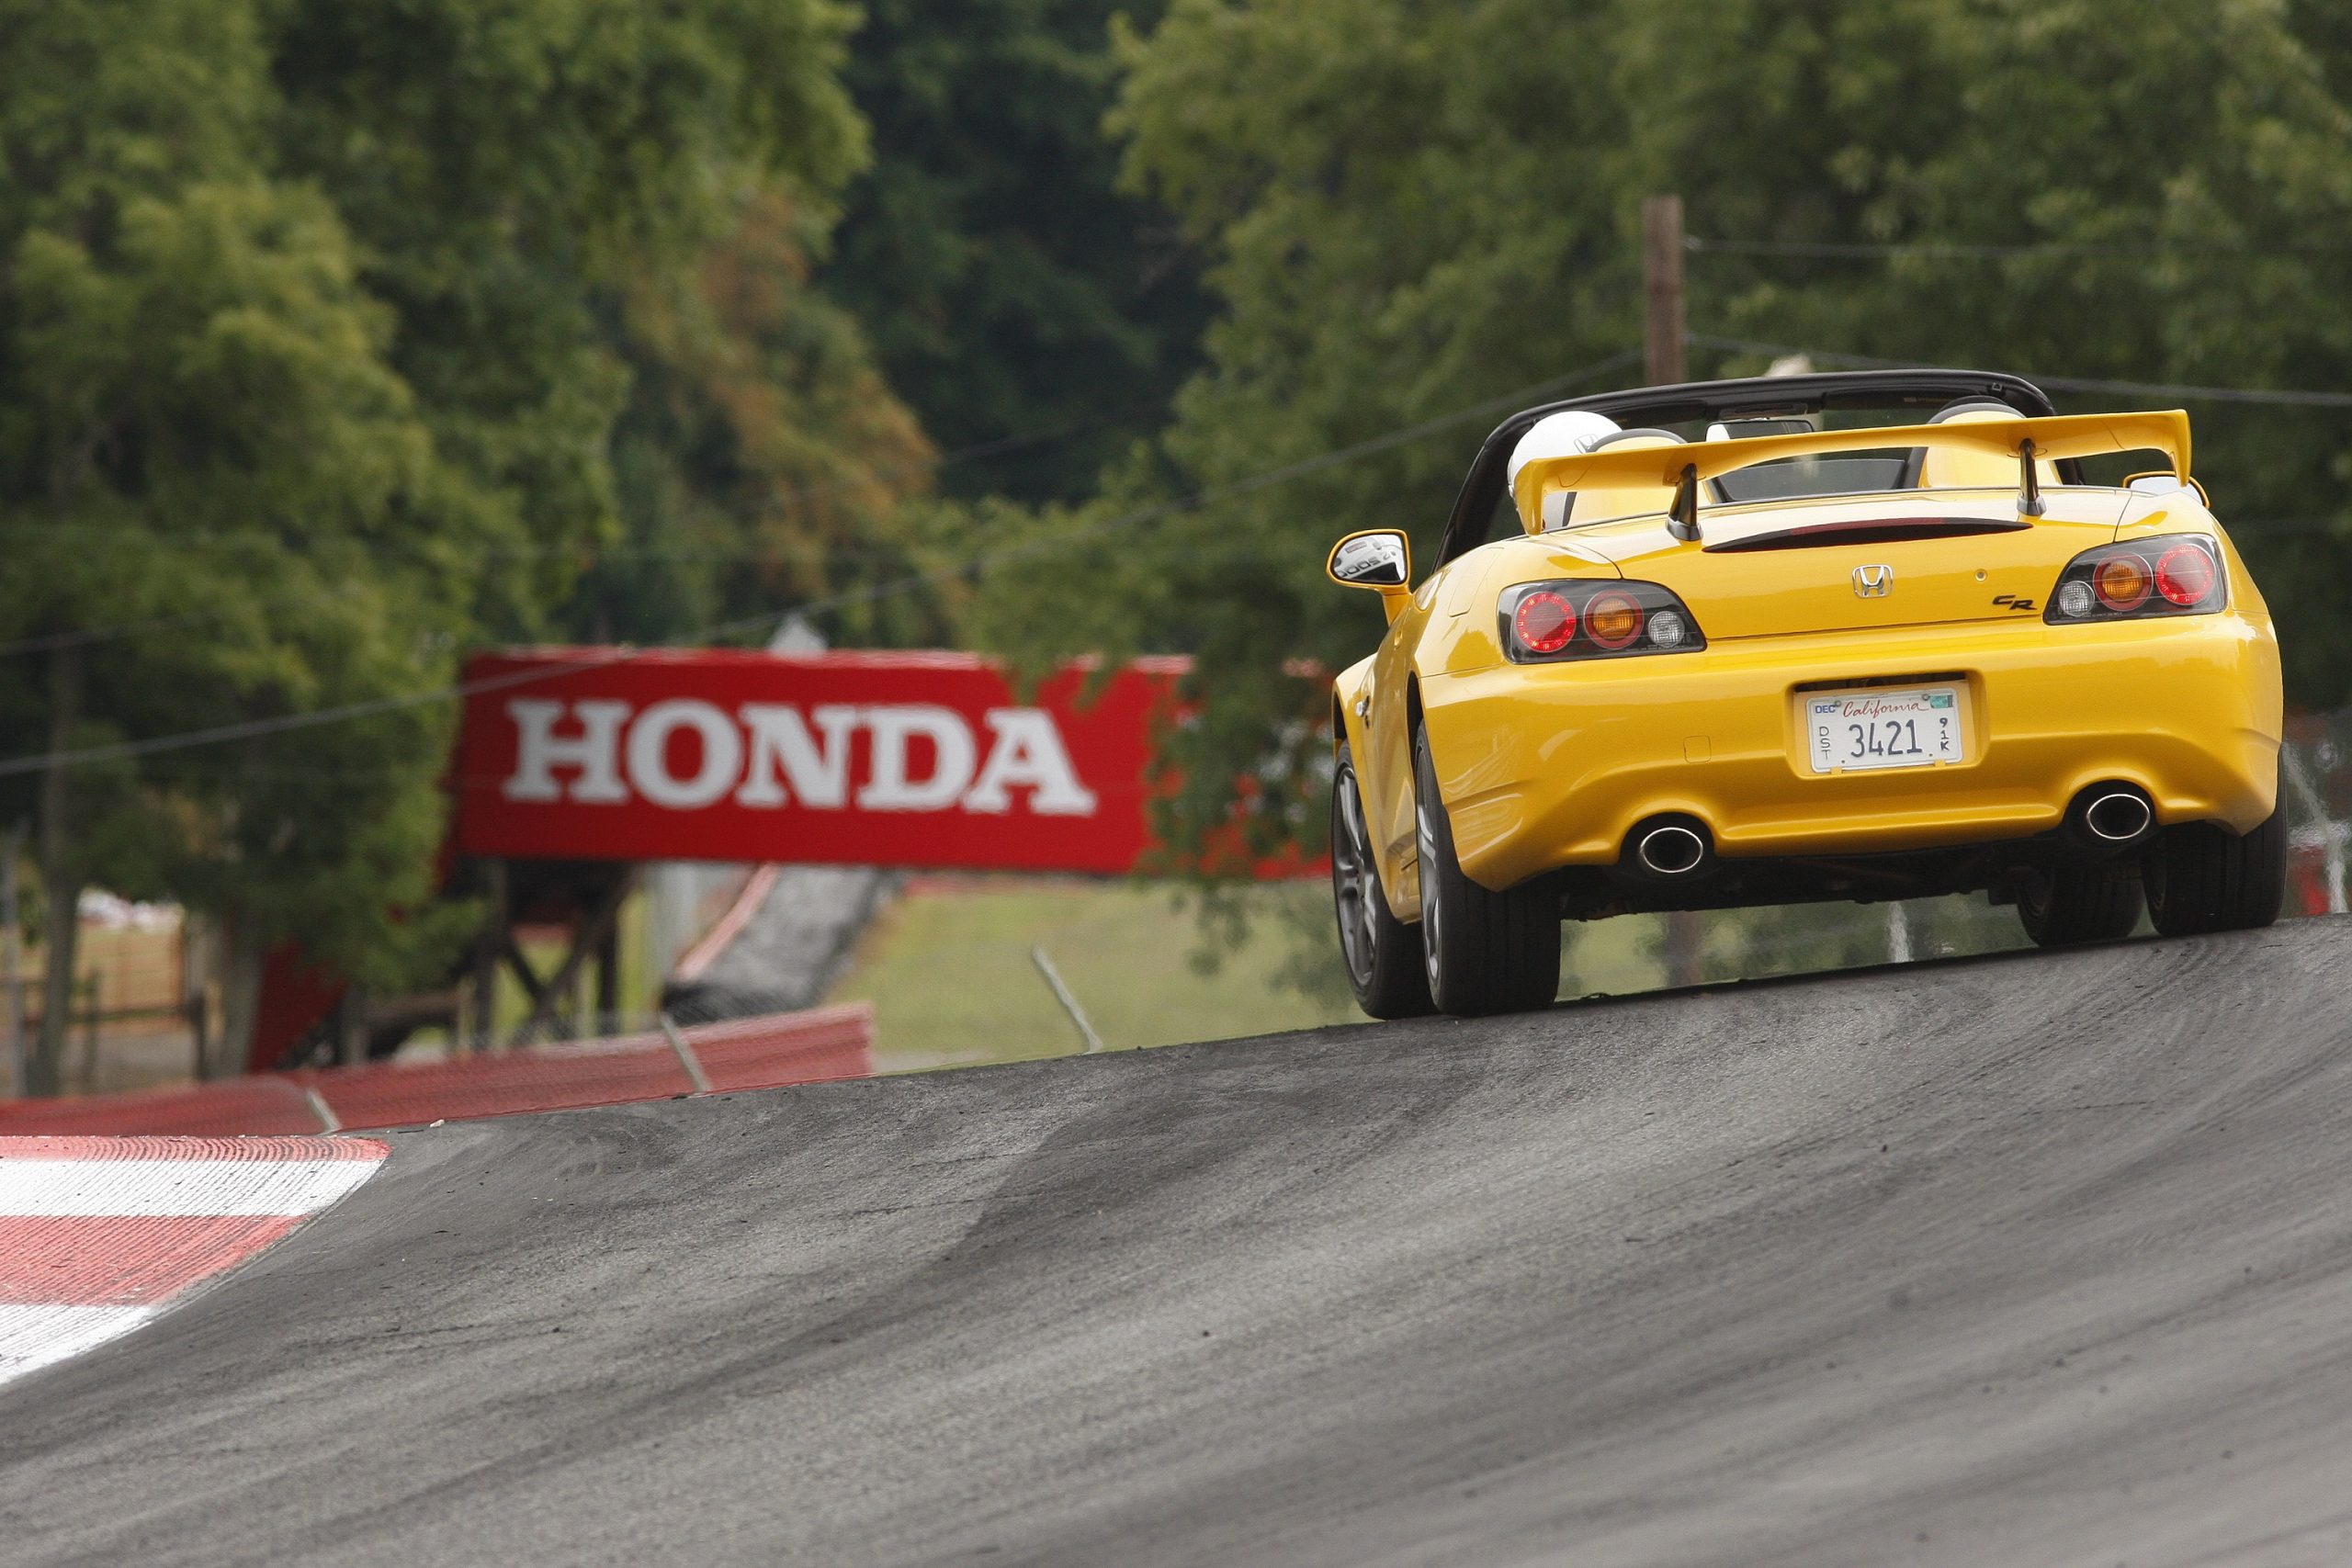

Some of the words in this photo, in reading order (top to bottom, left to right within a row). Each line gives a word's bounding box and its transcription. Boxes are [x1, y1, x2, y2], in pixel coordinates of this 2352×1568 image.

[1992, 594, 2038, 610] CR
[1815, 704, 1837, 714] DEC
[1843, 699, 1929, 718] California
[1849, 718, 1923, 758] 3421
[504, 697, 1097, 817] HONDA
